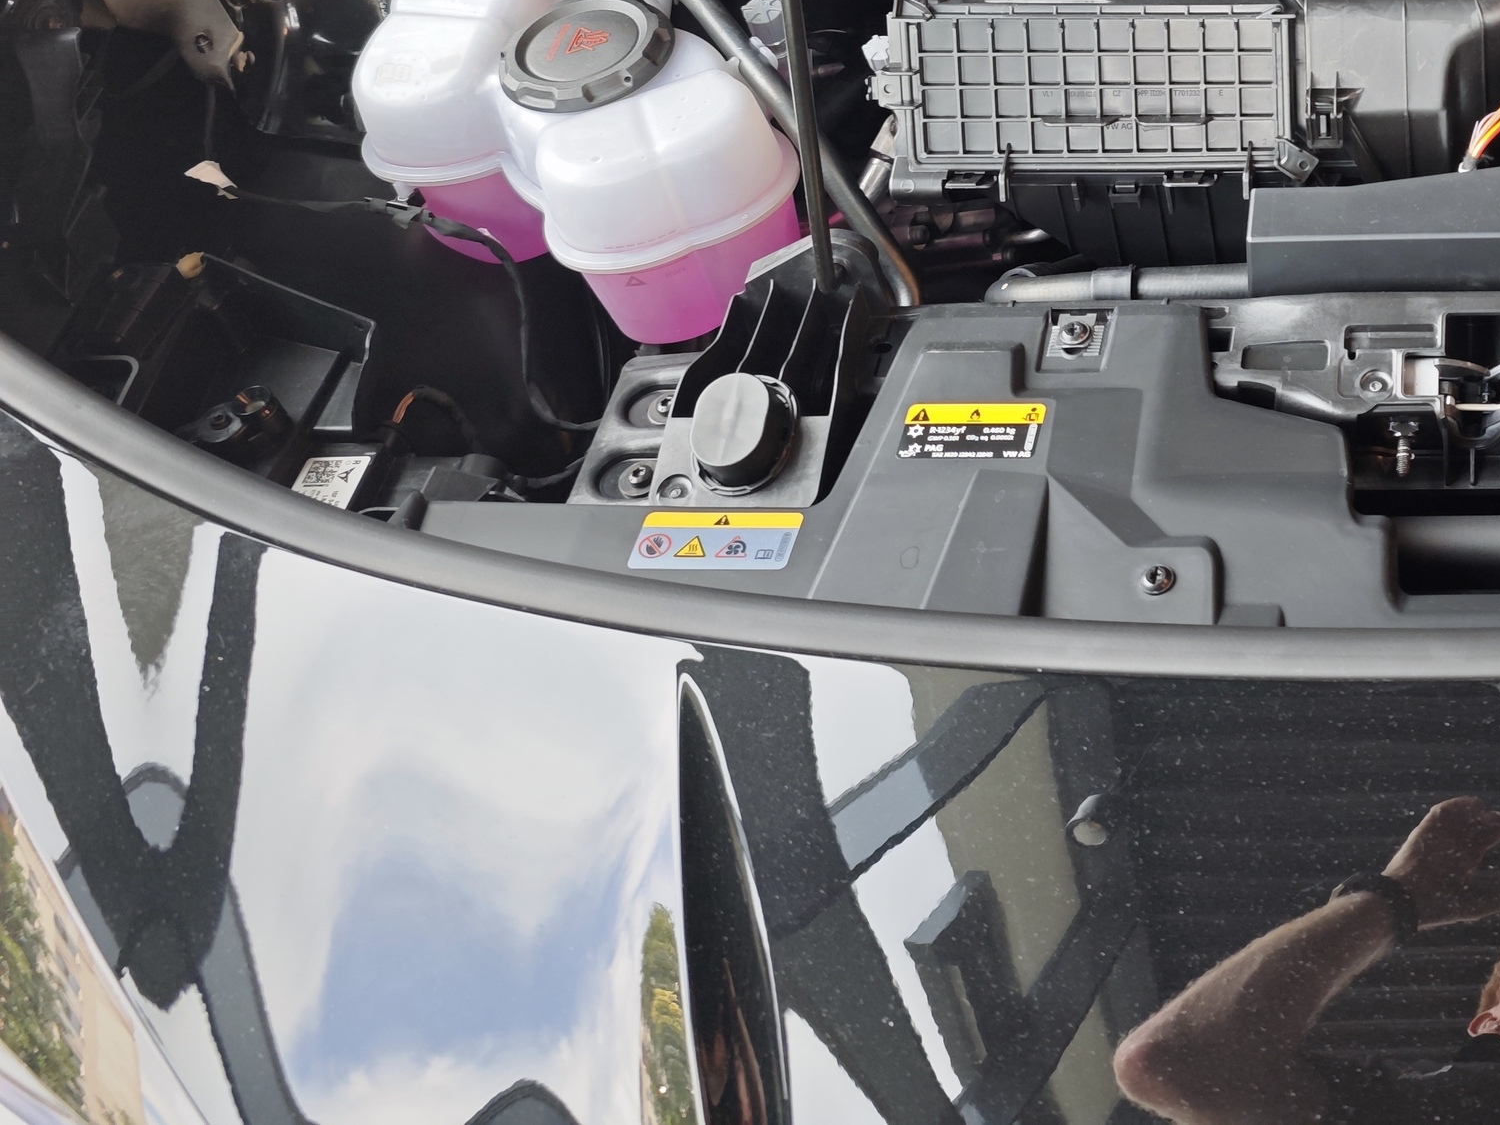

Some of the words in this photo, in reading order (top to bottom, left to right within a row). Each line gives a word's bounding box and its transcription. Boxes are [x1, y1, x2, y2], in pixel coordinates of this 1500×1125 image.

[1121, 122, 1133, 130] AG
[929, 426, 967, 436] R-1234yf
[924, 444, 944, 452] PAG
